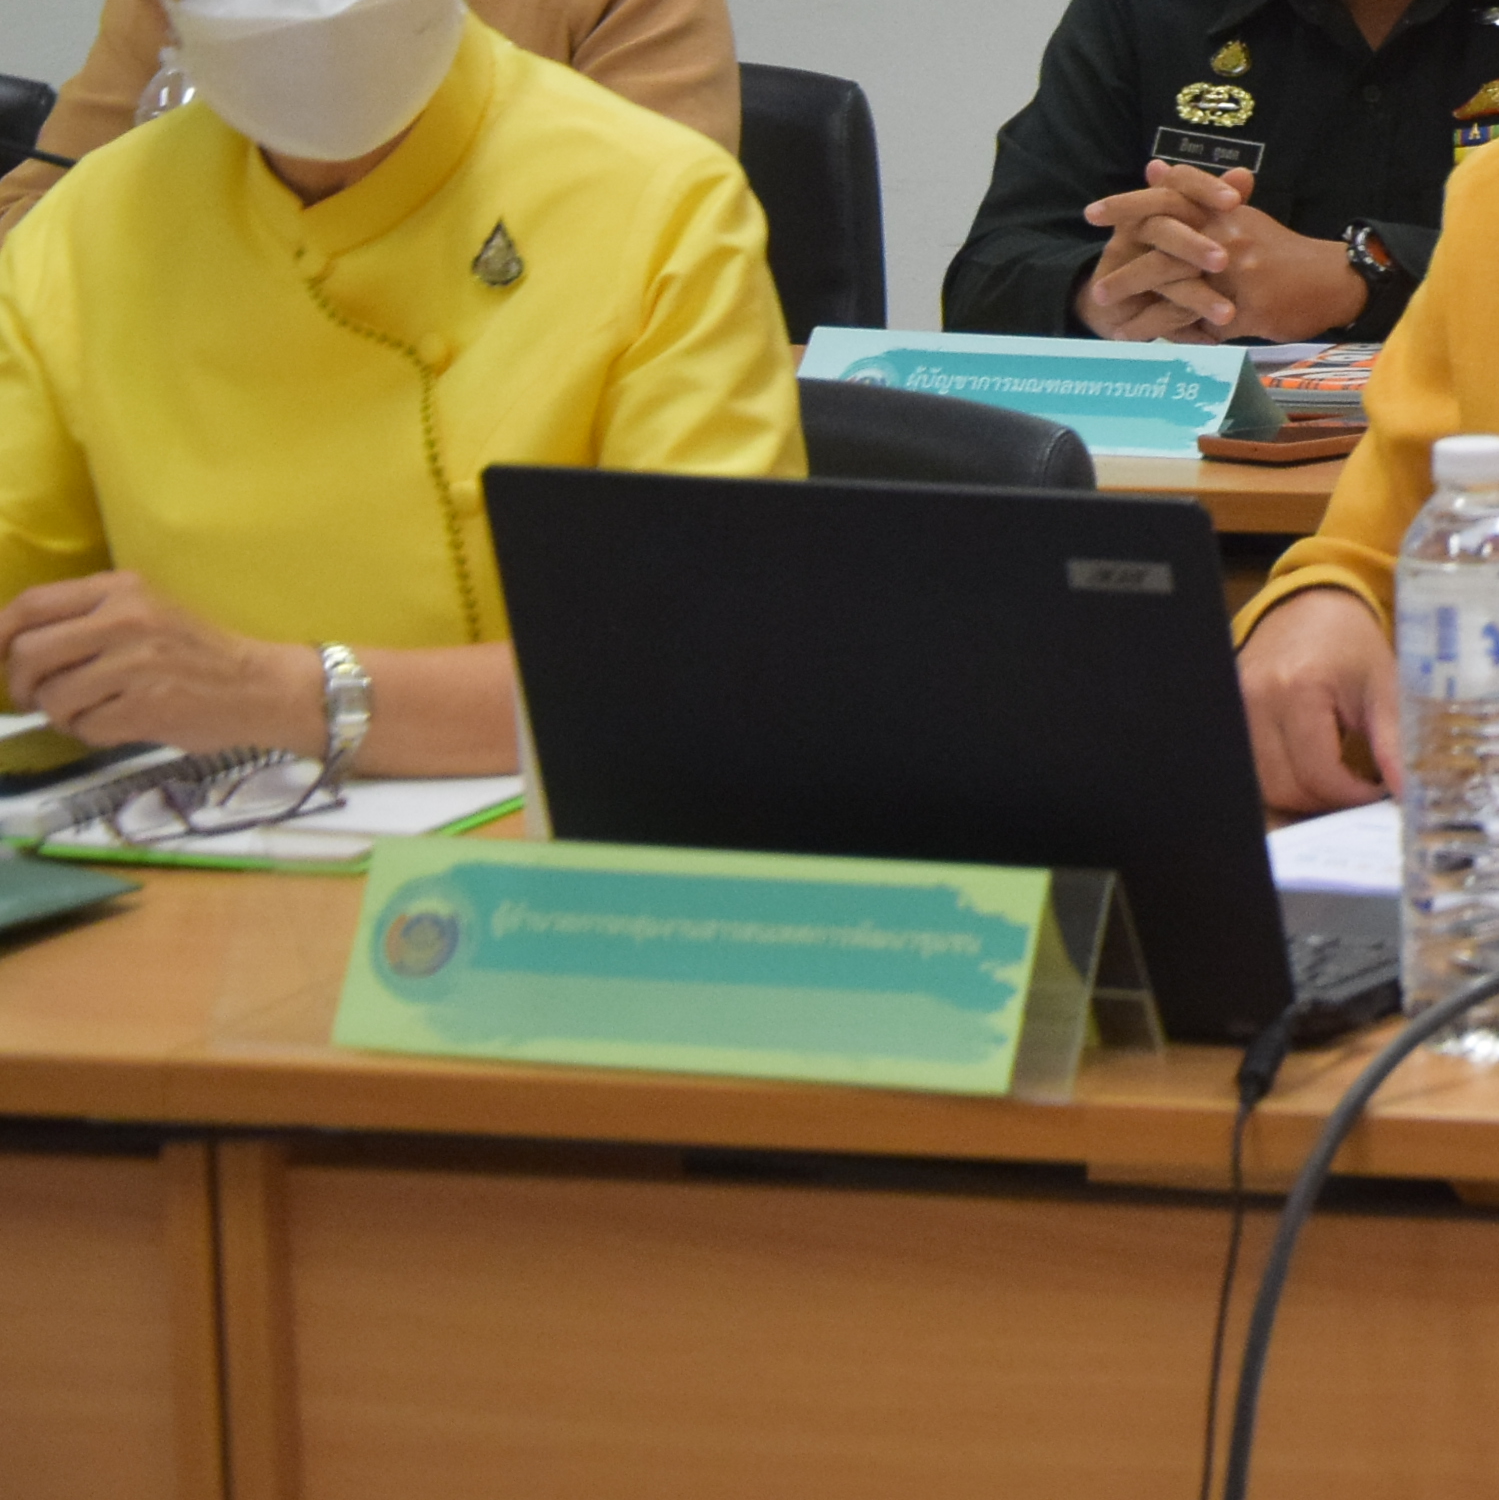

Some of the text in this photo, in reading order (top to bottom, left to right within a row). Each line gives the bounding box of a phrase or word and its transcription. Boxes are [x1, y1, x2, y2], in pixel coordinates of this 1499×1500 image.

[906, 365, 1199, 400] ผู้บัญชาการมณฑลทหารบกที่ 38
